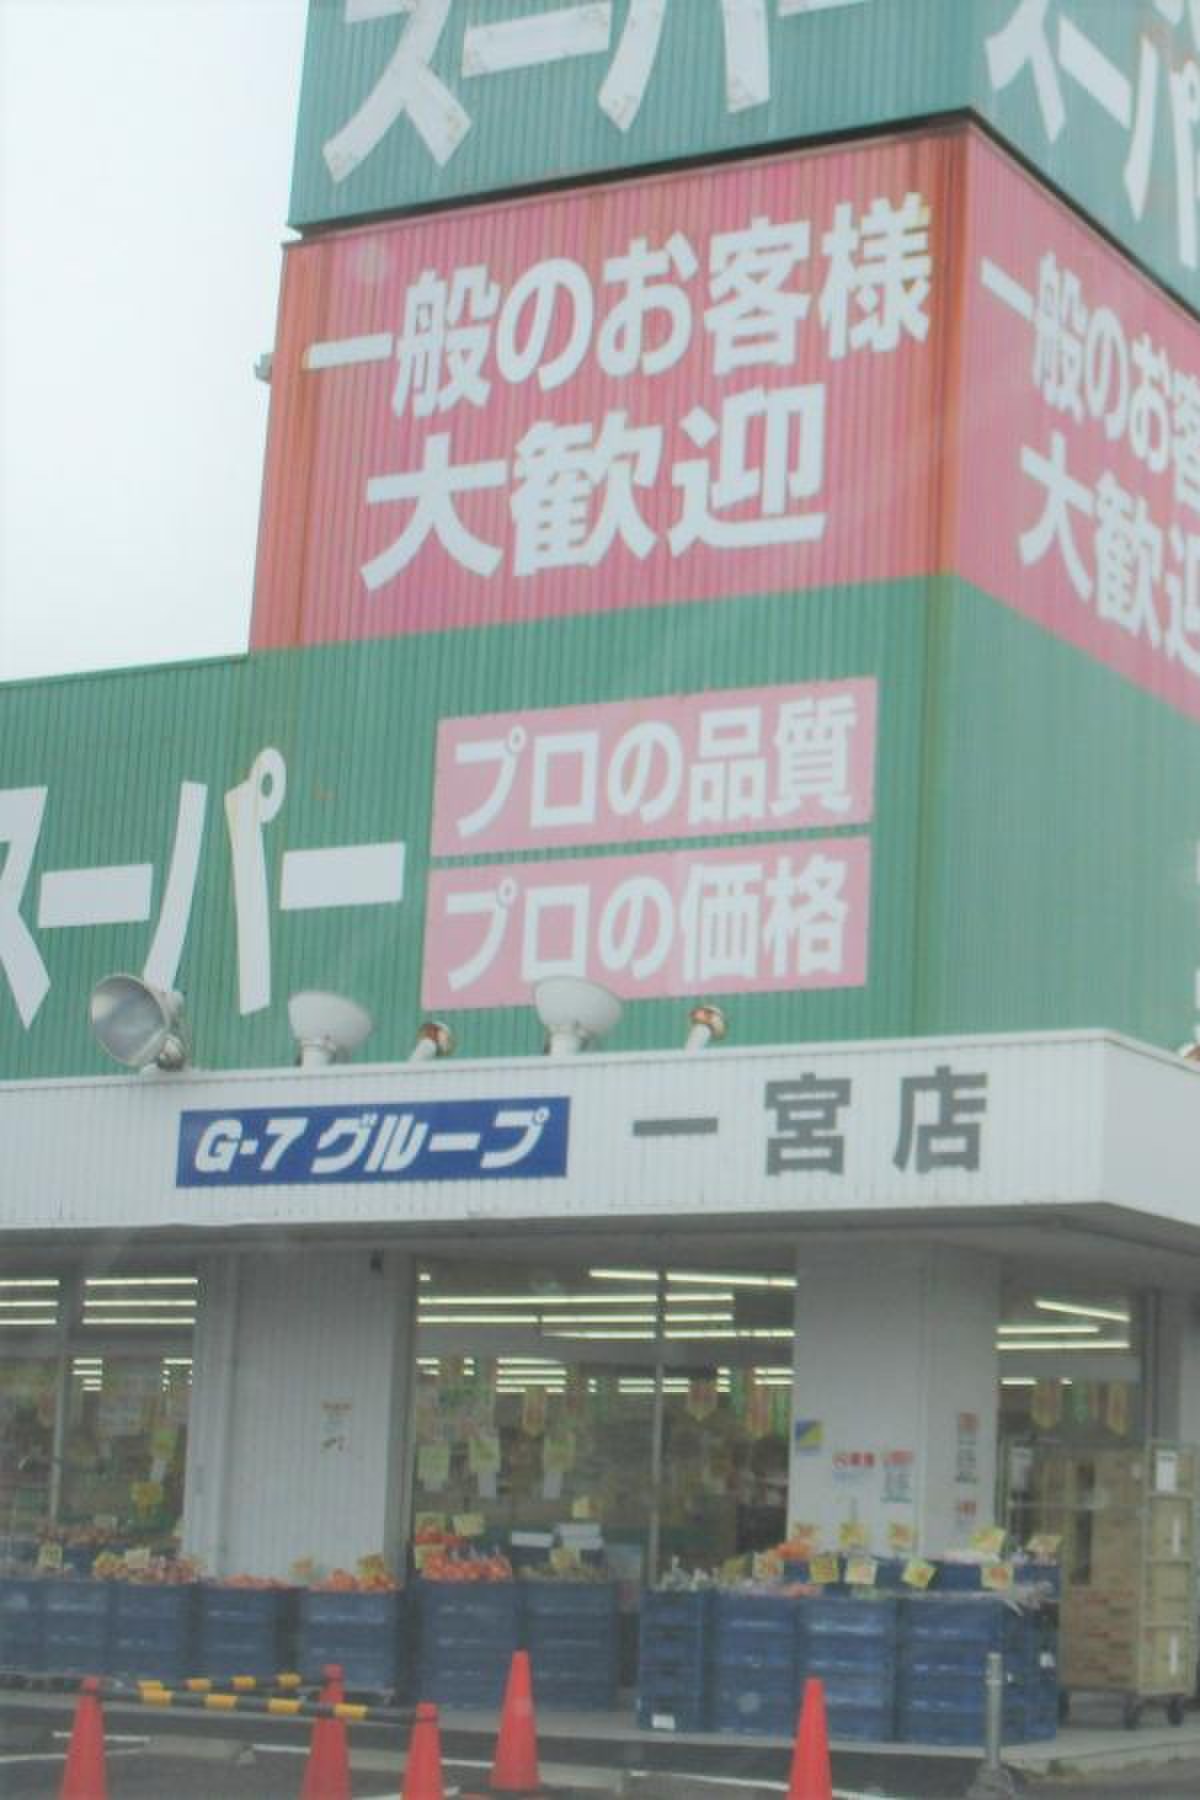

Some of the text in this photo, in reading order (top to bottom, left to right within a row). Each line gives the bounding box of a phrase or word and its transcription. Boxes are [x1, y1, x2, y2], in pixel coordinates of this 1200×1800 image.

[322, 0, 868, 183] スー
[306, 192, 932, 418] 一般のお客様
[360, 384, 827, 592] 大歓迎
[455, 694, 856, 839] プロの品質
[445, 855, 849, 993] プロの価格
[632, 1065, 990, 1176] 一宮店
